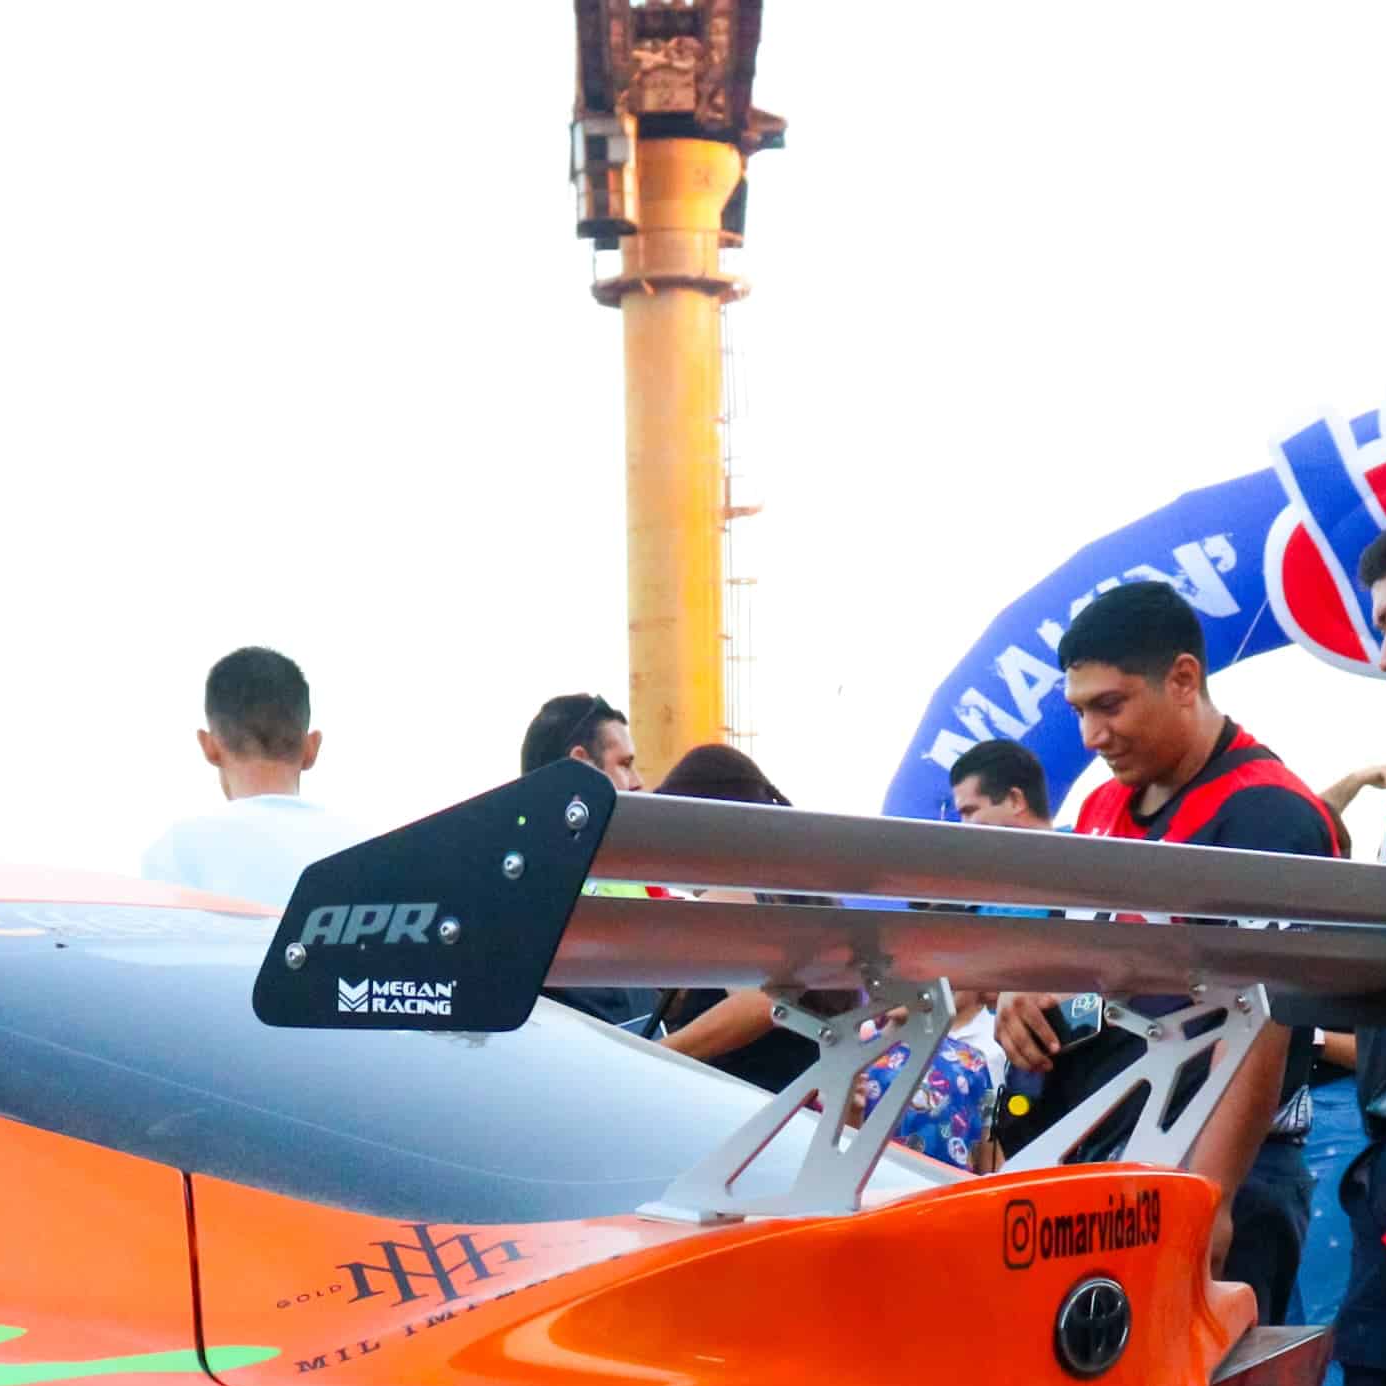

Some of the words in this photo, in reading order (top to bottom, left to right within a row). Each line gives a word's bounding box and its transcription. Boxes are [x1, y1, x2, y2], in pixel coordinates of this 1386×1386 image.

[301, 903, 440, 945] APR
[372, 980, 452, 998] MEGAN
[372, 998, 452, 1016] RACING
[1040, 1189, 1160, 1260] omarvidal39
